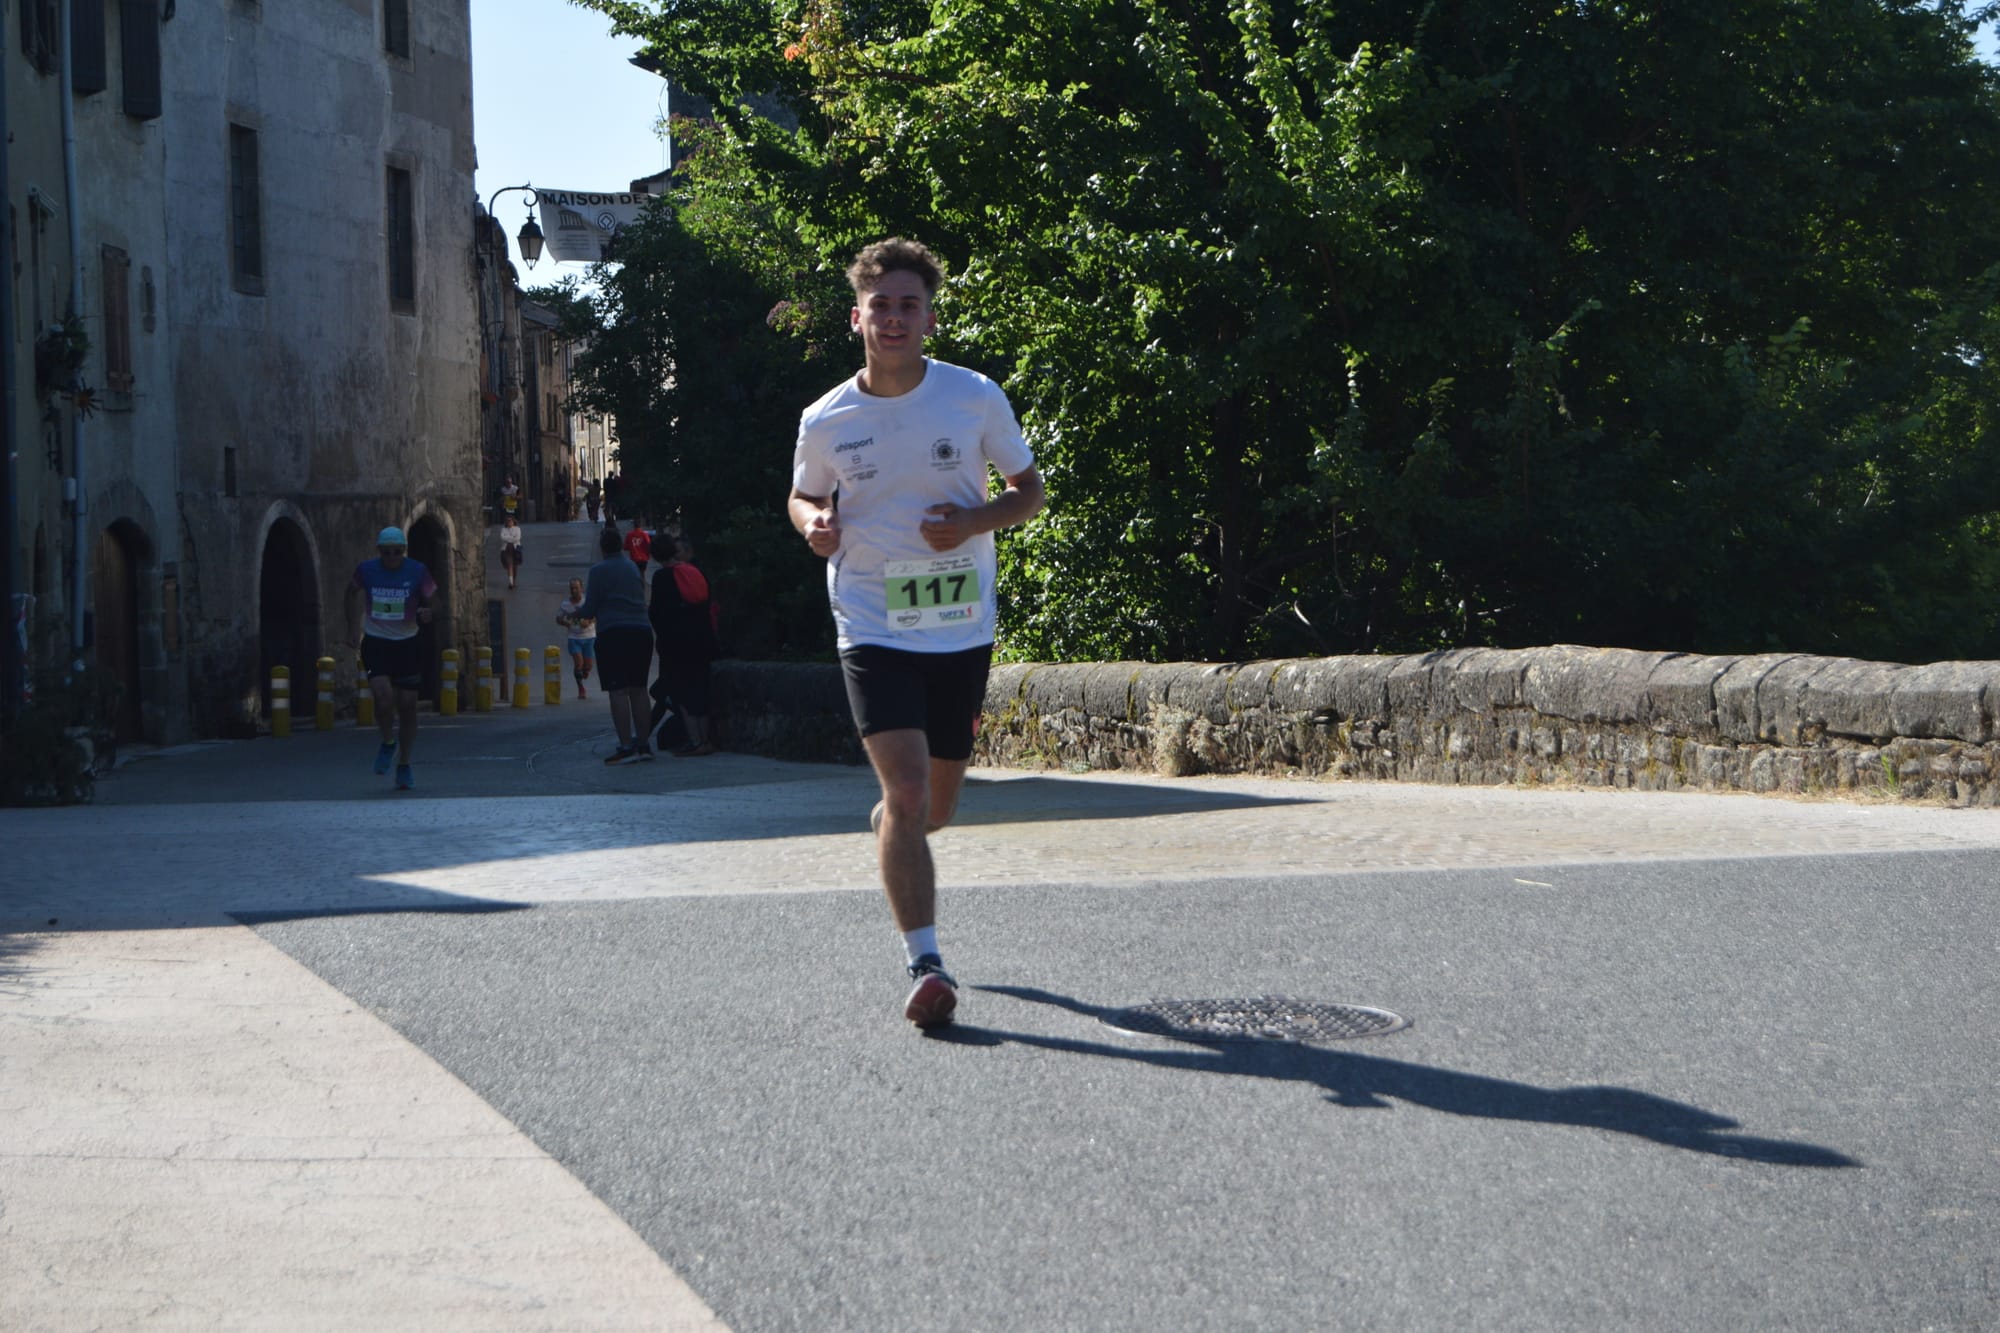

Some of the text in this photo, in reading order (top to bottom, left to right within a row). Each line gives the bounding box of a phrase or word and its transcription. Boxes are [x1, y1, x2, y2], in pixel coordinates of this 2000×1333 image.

[543, 193, 614, 206] MAISON
[835, 437, 874, 453] uhlsport
[901, 574, 966, 607] 117
